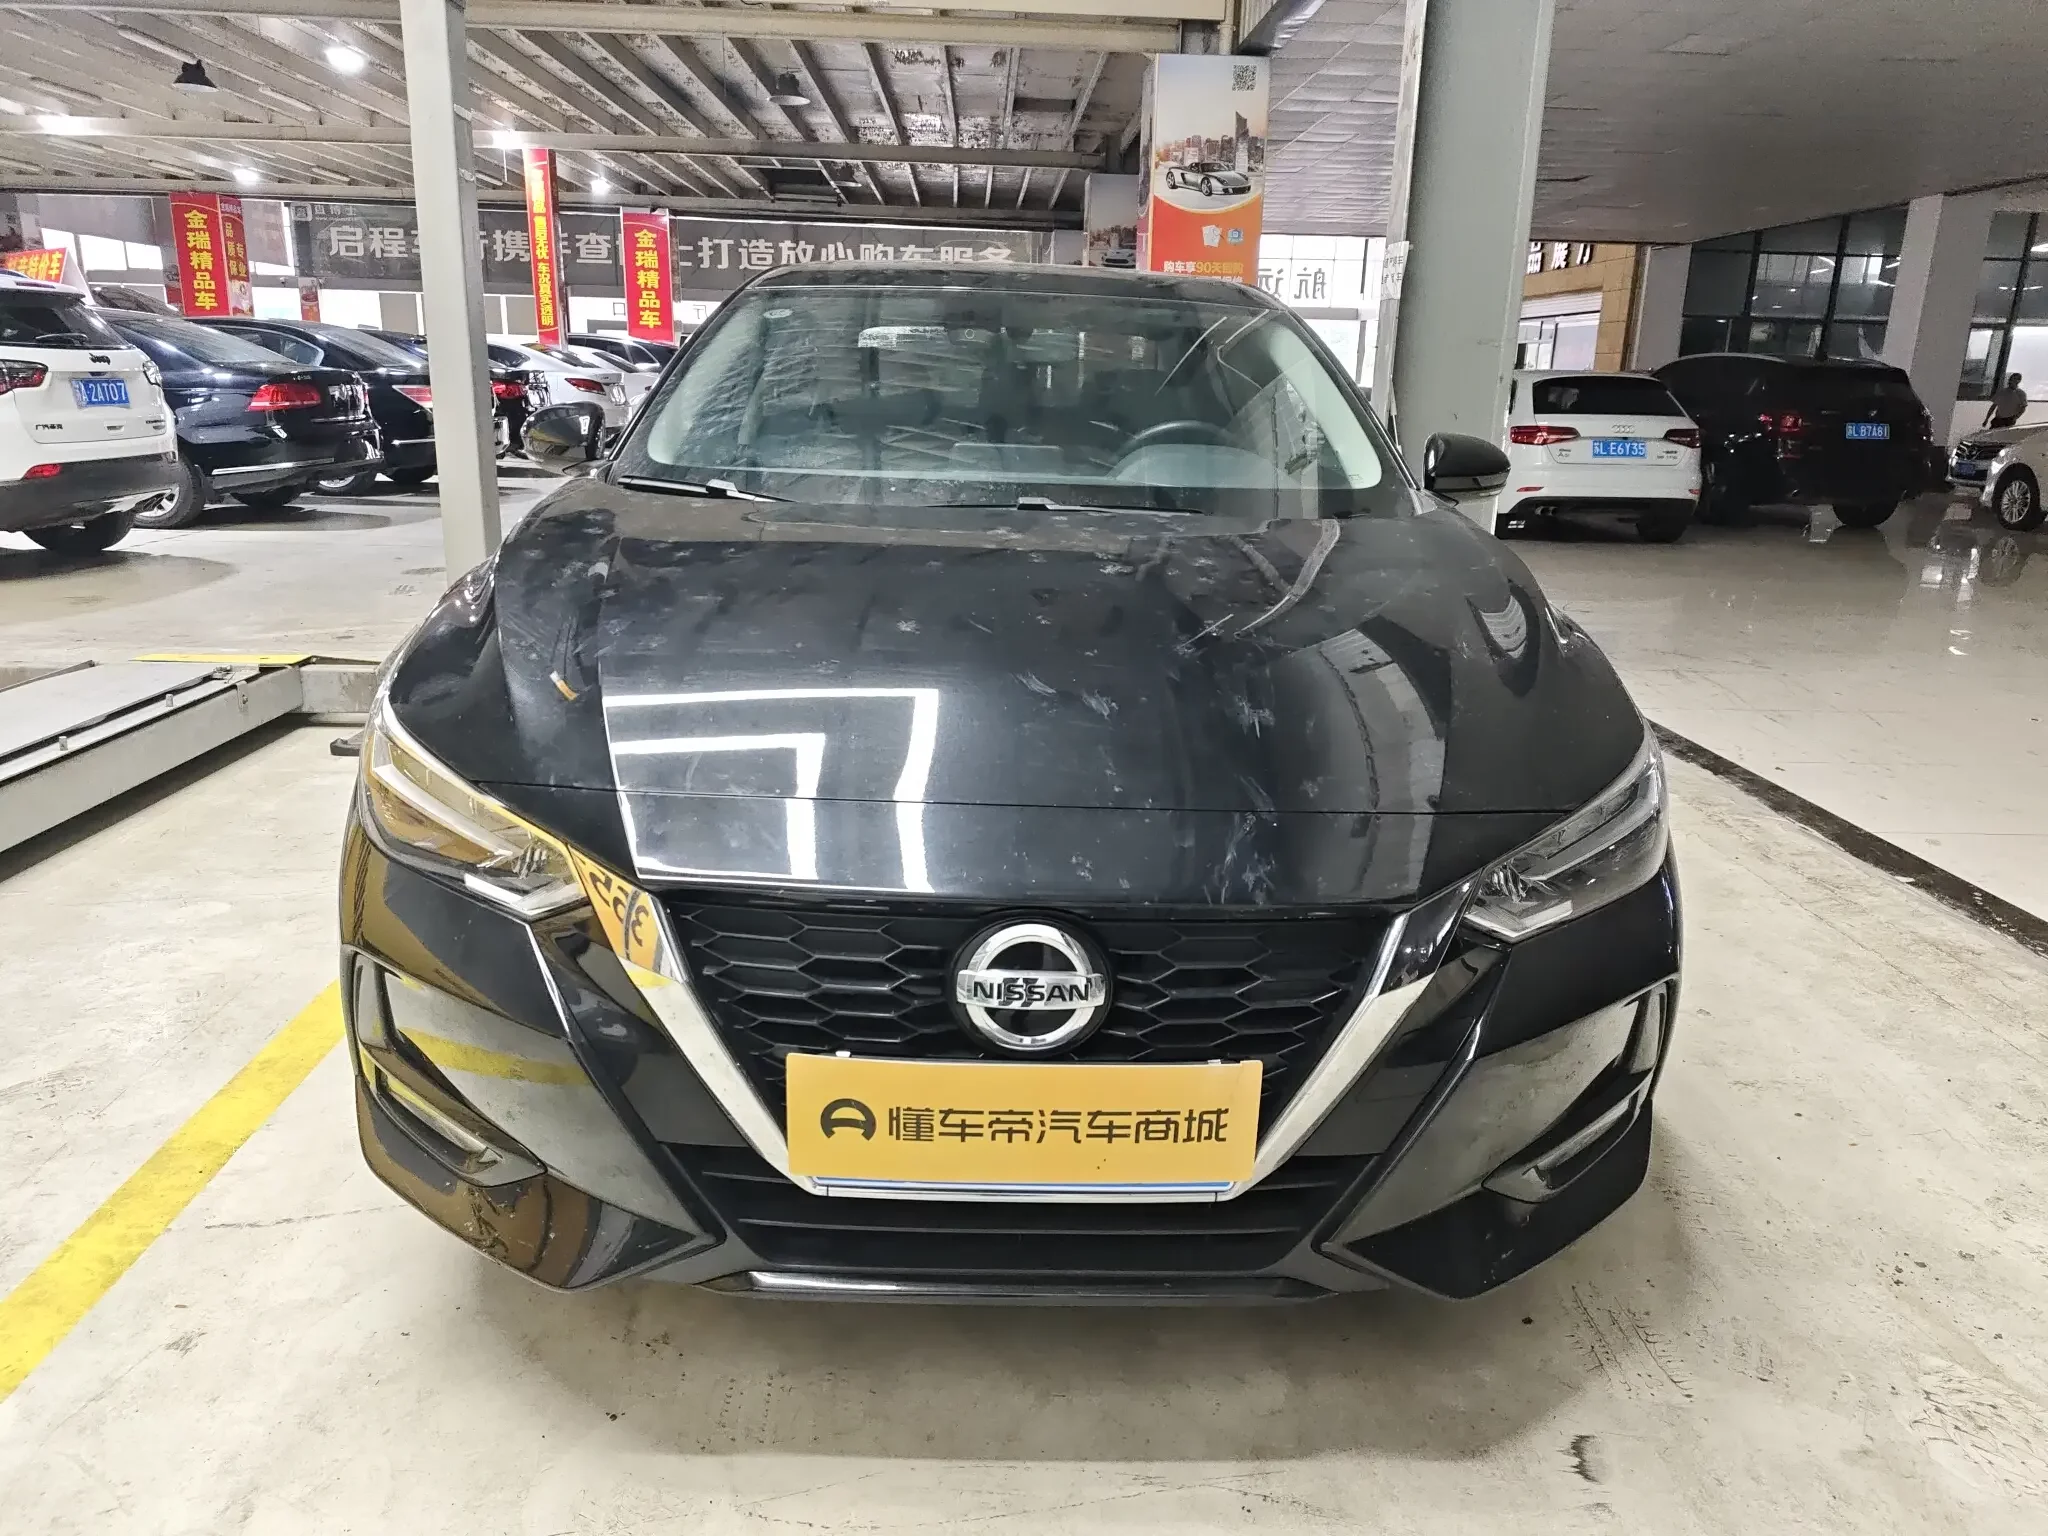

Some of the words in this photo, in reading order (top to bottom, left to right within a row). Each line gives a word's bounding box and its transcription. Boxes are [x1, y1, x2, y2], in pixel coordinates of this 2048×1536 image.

[184, 209, 218, 311] 金瑞精品车
[634, 229, 662, 328] 金瑞精品车
[973, 981, 1090, 1001] NISSAN
[888, 1107, 1230, 1144] 懂车帝汽车商城
